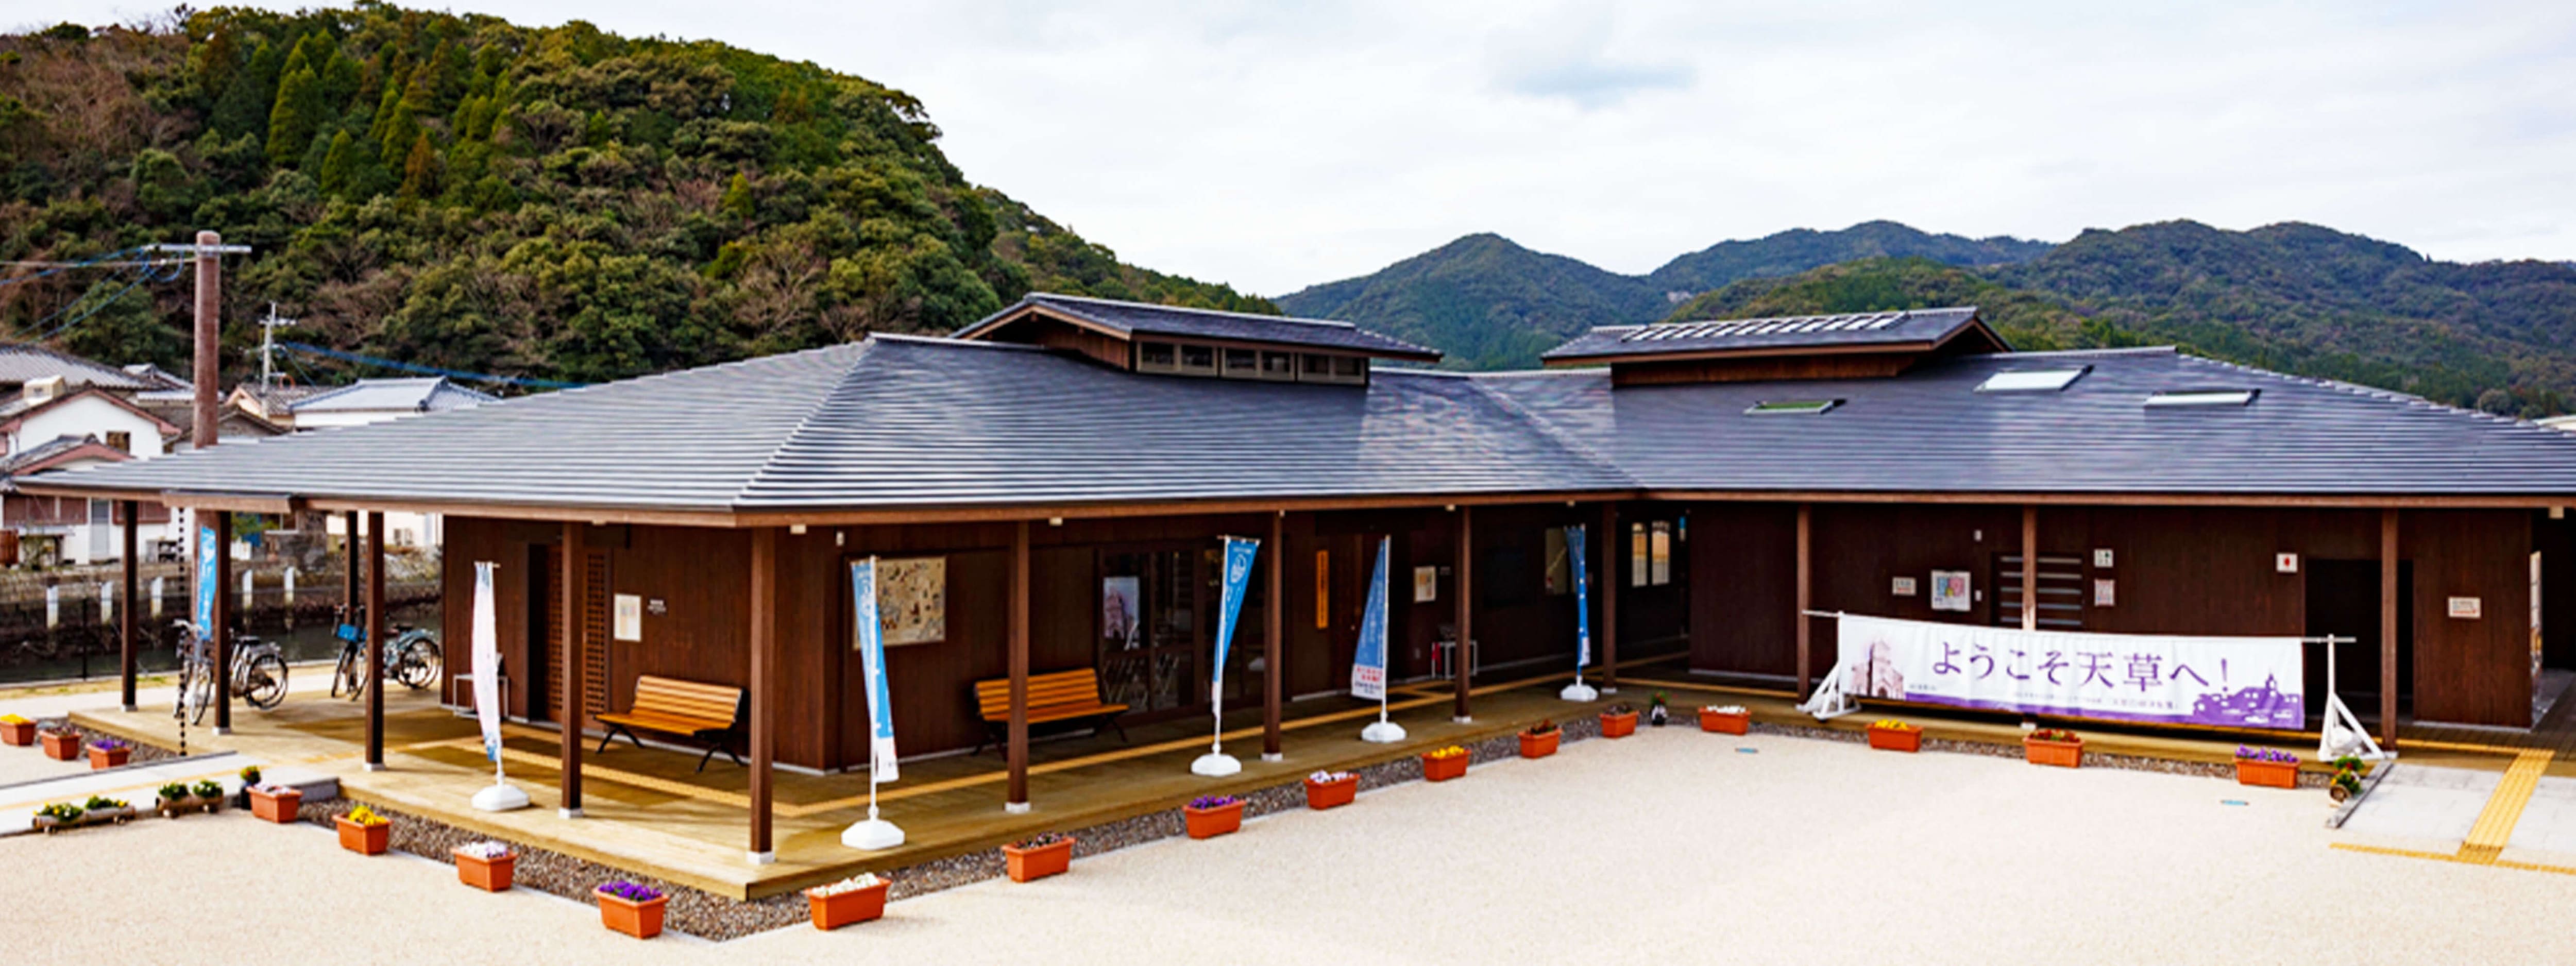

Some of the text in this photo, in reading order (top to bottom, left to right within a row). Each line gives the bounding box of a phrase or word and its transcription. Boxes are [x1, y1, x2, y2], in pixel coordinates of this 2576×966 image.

[1933, 641, 2228, 692] ようこそ天草へ!
